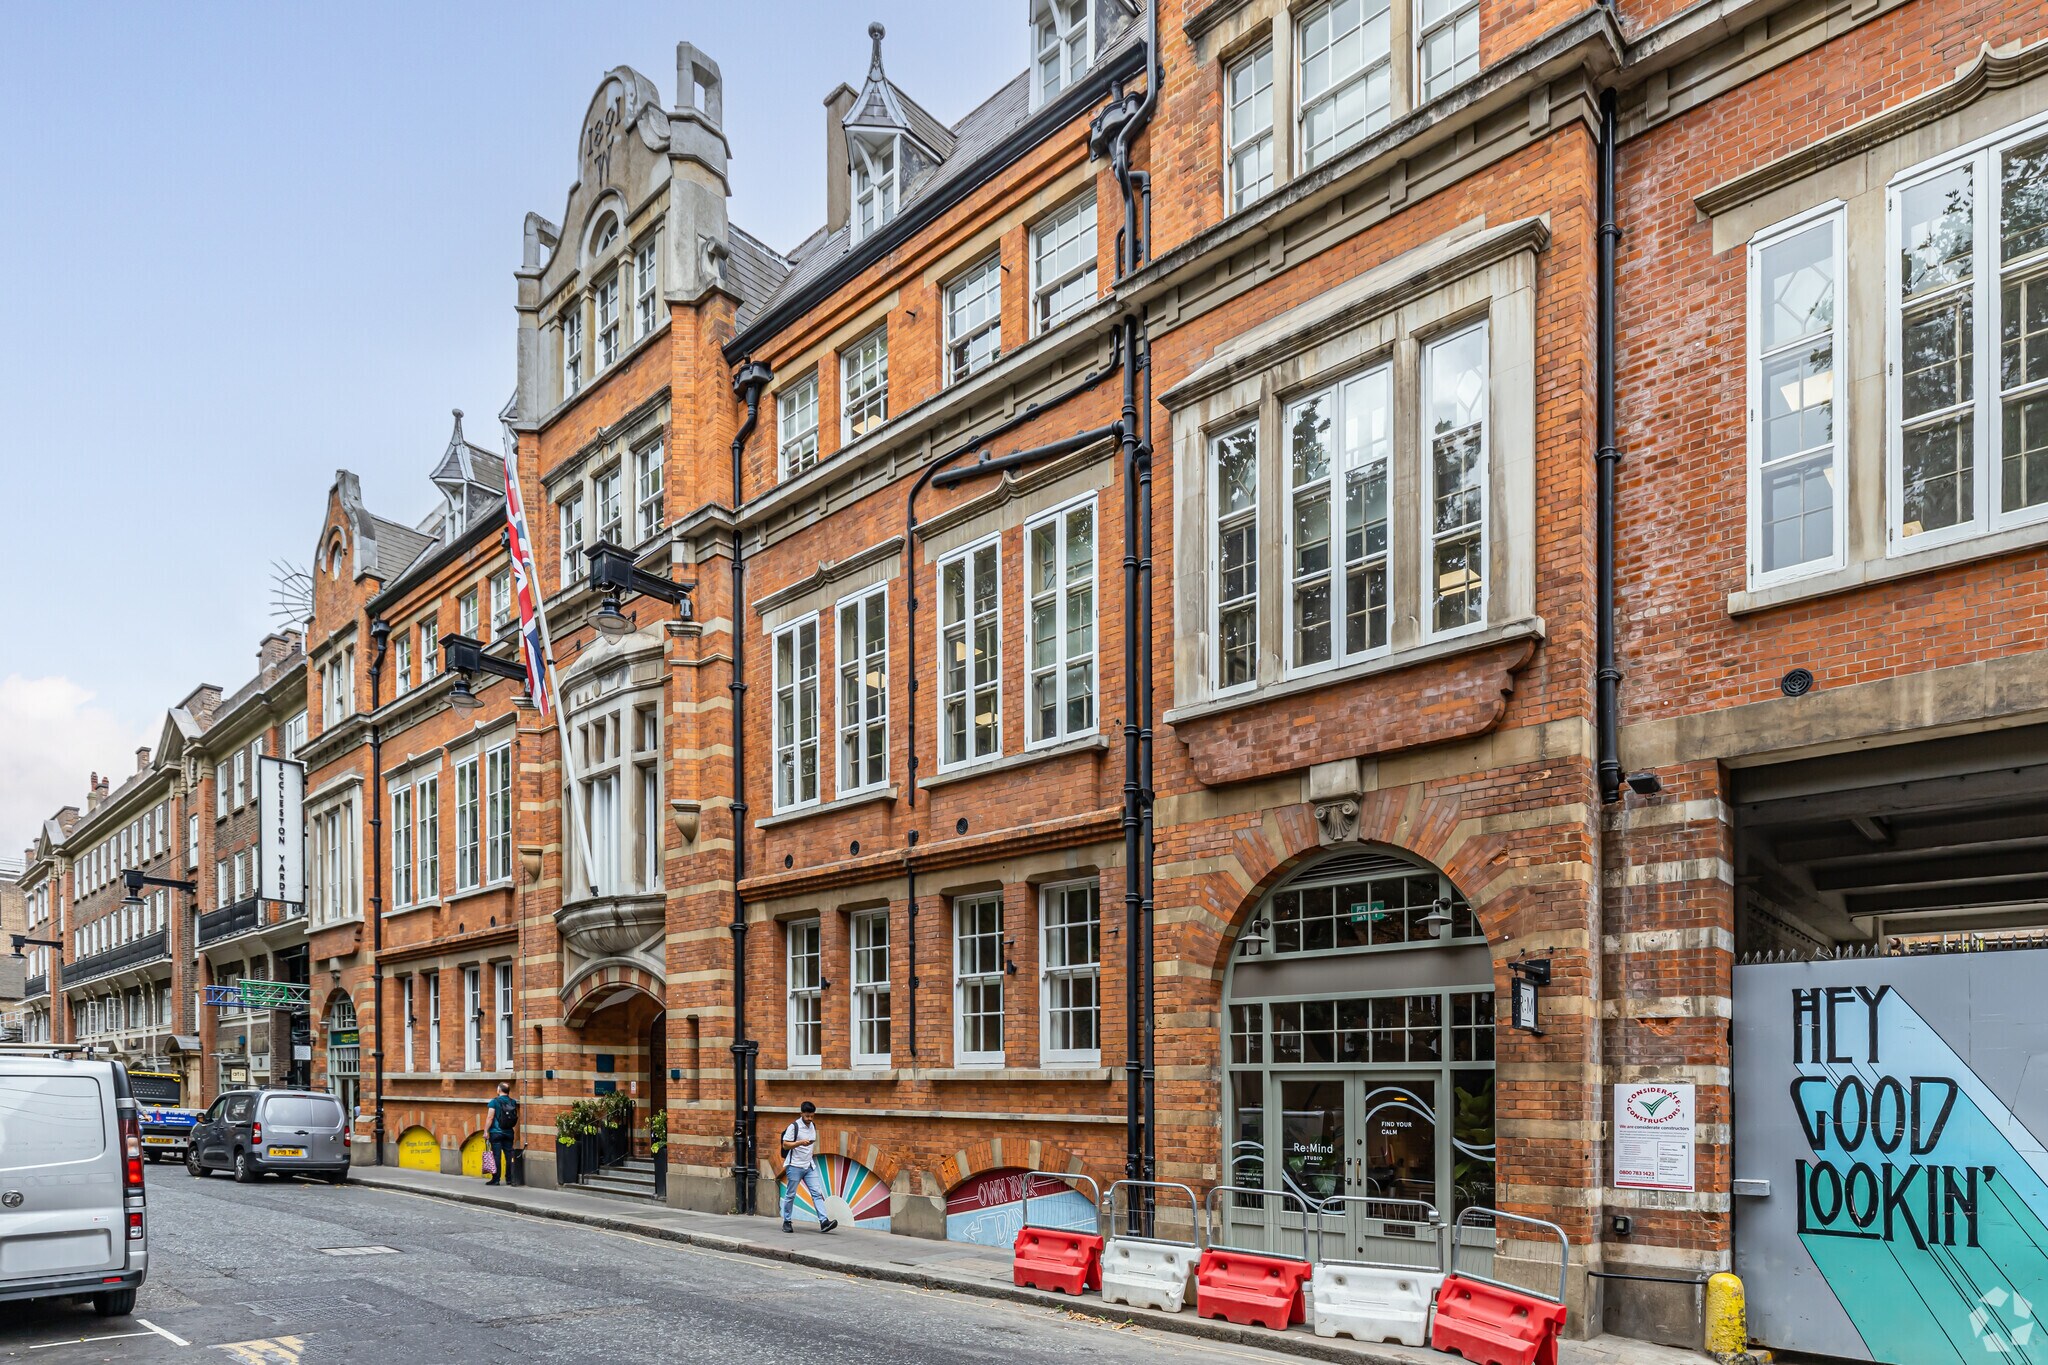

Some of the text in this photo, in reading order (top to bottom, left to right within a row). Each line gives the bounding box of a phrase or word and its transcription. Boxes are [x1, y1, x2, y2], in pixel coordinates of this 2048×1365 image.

[588, 96, 621, 157] 1891
[1791, 985, 1892, 1064] HEY
[1626, 1106, 1681, 1124] CONSTRUCTORS
[1627, 1087, 1681, 1104] CONSIDERATE
[1790, 1074, 1958, 1155] GOOD
[1293, 1143, 1334, 1154] Re:Mind
[977, 1178, 1008, 1207] OWN
[1795, 1159, 1996, 1250] LOOKIN'
